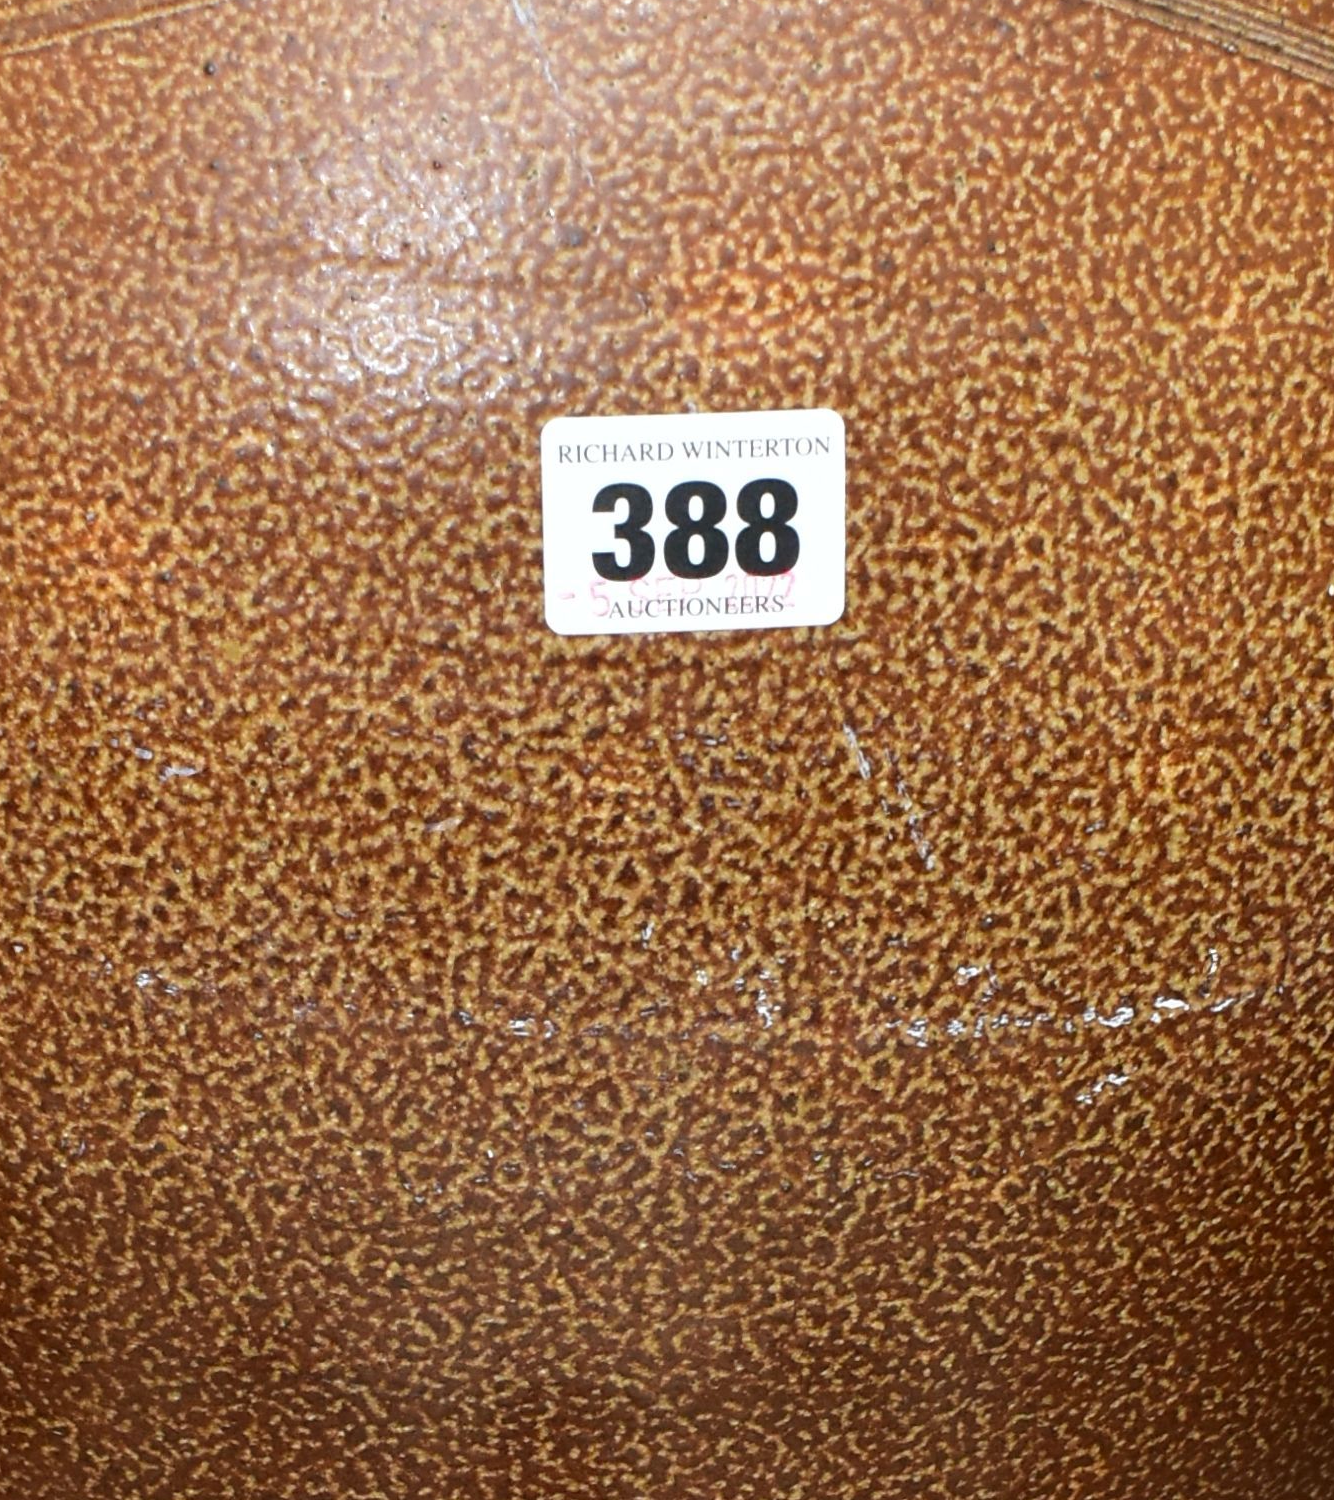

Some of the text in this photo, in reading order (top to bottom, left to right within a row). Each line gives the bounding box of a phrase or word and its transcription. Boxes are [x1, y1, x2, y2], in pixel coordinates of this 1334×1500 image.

[558, 437, 831, 464] RICHARD WINTERTON
[592, 478, 800, 581] 388
[608, 594, 785, 619] AUCTIONEERS
